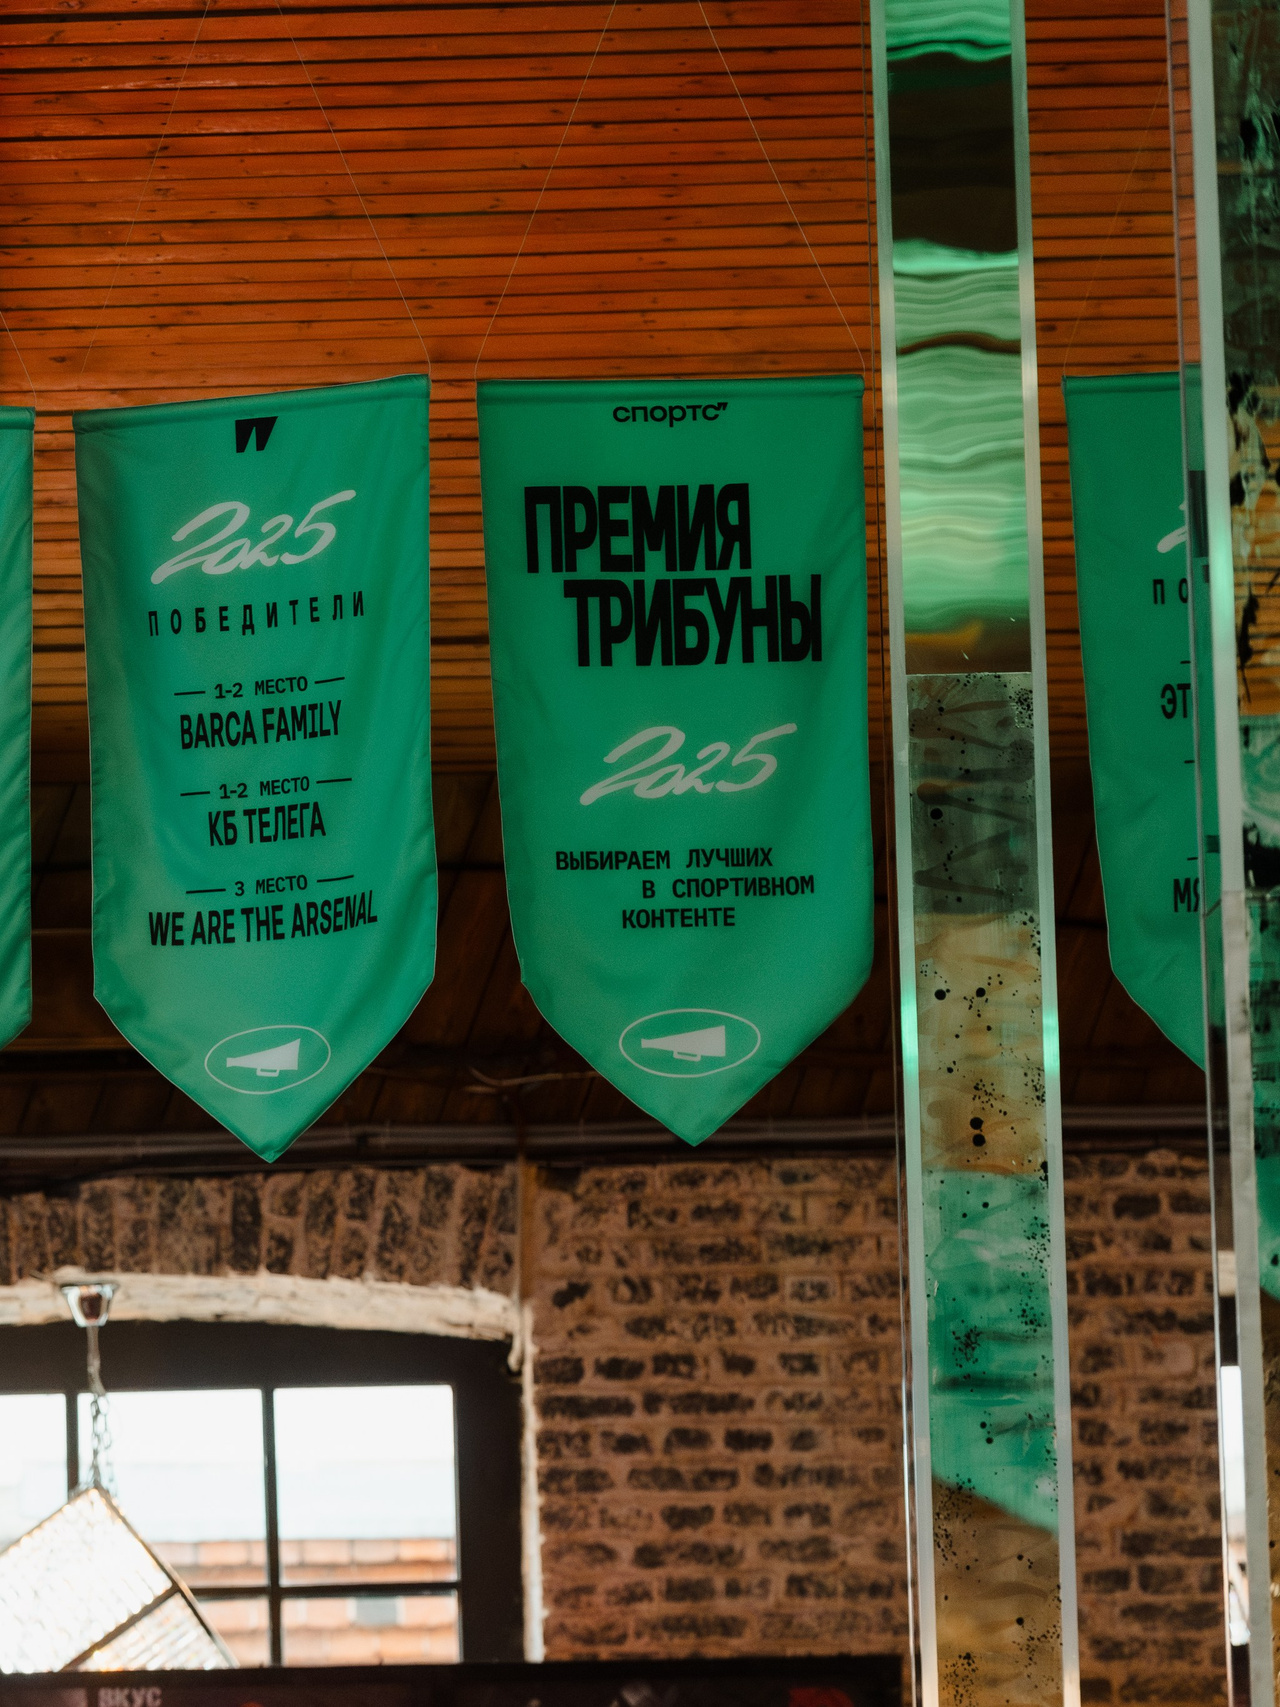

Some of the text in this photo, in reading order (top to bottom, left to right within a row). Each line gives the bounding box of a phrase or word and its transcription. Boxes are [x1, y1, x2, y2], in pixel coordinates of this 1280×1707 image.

[150, 489, 356, 585] 2025
[523, 483, 753, 574] ПРЕМИЯ
[148, 590, 365, 637] ПОБЕДИТЕЛИ
[563, 573, 823, 668] ТРИБУНЫ
[214, 676, 308, 699] 1-2 МЕСТО
[180, 700, 342, 750] BARCA FAMILY
[580, 723, 798, 806] 2025
[219, 777, 310, 799] 1-2 МЕСТО
[208, 801, 326, 846] КБ ТЕЛЕГА
[555, 847, 774, 871] ВЫБИРАЕМ ЛУЧШИХ
[233, 875, 308, 897] 3 МЕСТО
[642, 874, 815, 899] В СПОРТИВНОМ
[149, 889, 379, 947] WE ARE THE ARSENAL
[621, 907, 736, 930] КОНТЕНТЕ
